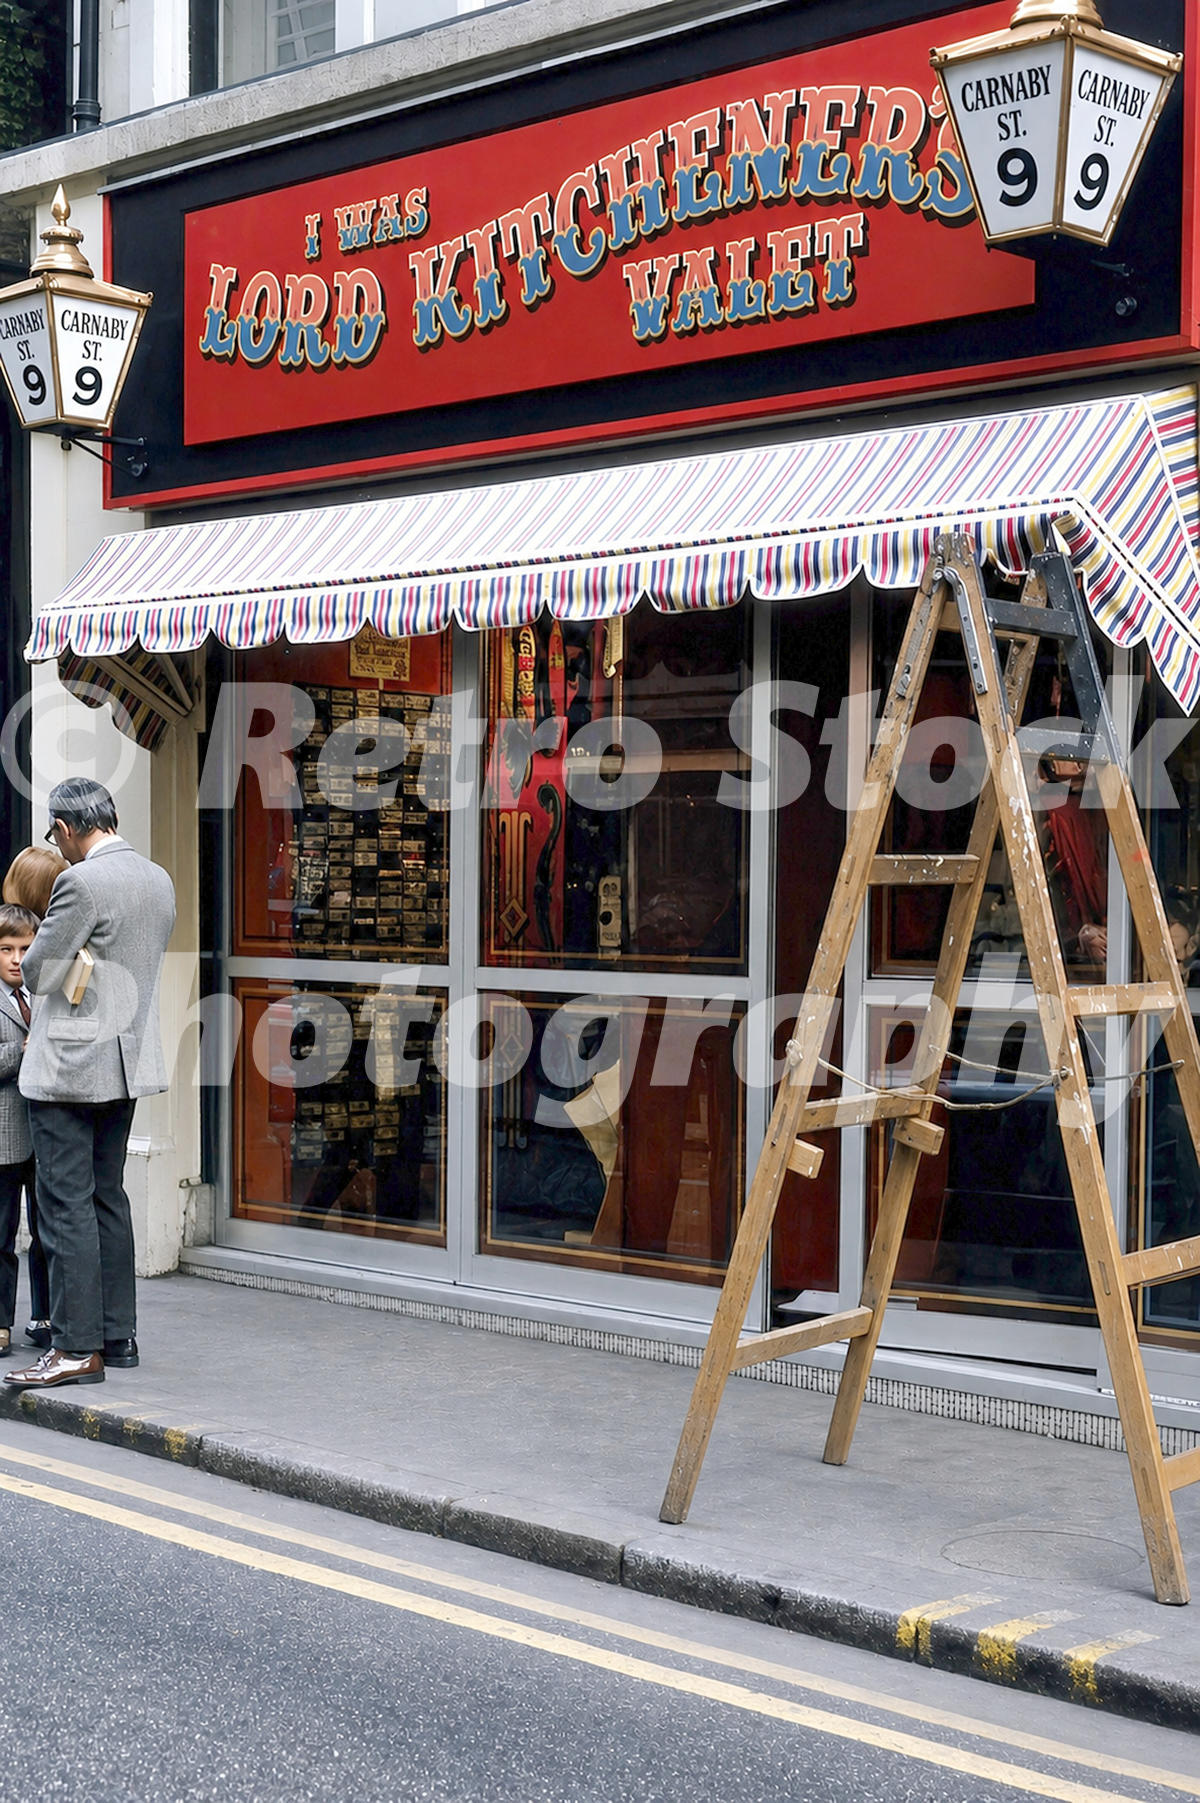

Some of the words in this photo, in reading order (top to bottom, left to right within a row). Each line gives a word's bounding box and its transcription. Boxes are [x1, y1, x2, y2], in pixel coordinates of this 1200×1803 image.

[961, 64, 1052, 112] CARNABY
[1077, 69, 1150, 120] CARNABY
[997, 110, 1027, 142] ST.
[1093, 114, 1117, 147] ST.
[997, 147, 1038, 207] 9
[1073, 152, 1110, 211] 9
[304, 212, 321, 260] I
[335, 187, 430, 252] WAS
[623, 212, 865, 341] VALET
[61, 309, 129, 341] CARNABY
[200, 263, 387, 368] LORD
[16, 339, 36, 361] ST.
[82, 339, 103, 362] ST.
[22, 364, 47, 406] 9
[71, 366, 103, 406] 9
